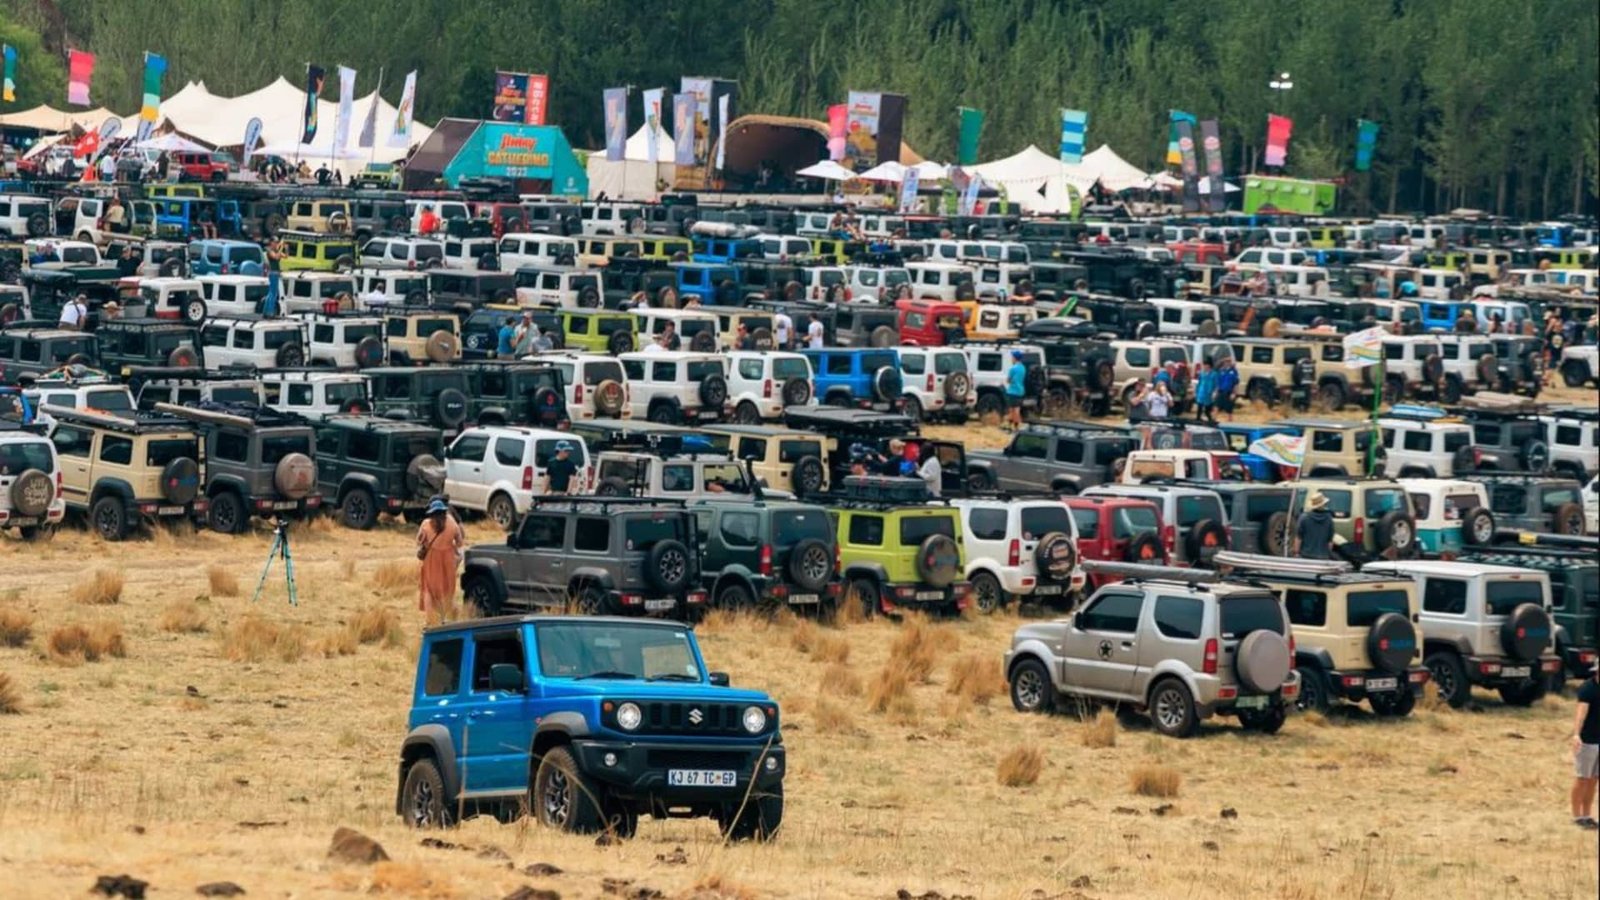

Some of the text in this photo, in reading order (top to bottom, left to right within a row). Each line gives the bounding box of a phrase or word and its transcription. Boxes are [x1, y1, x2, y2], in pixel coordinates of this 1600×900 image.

[671, 771, 734, 784] KJ 67 TC GP
